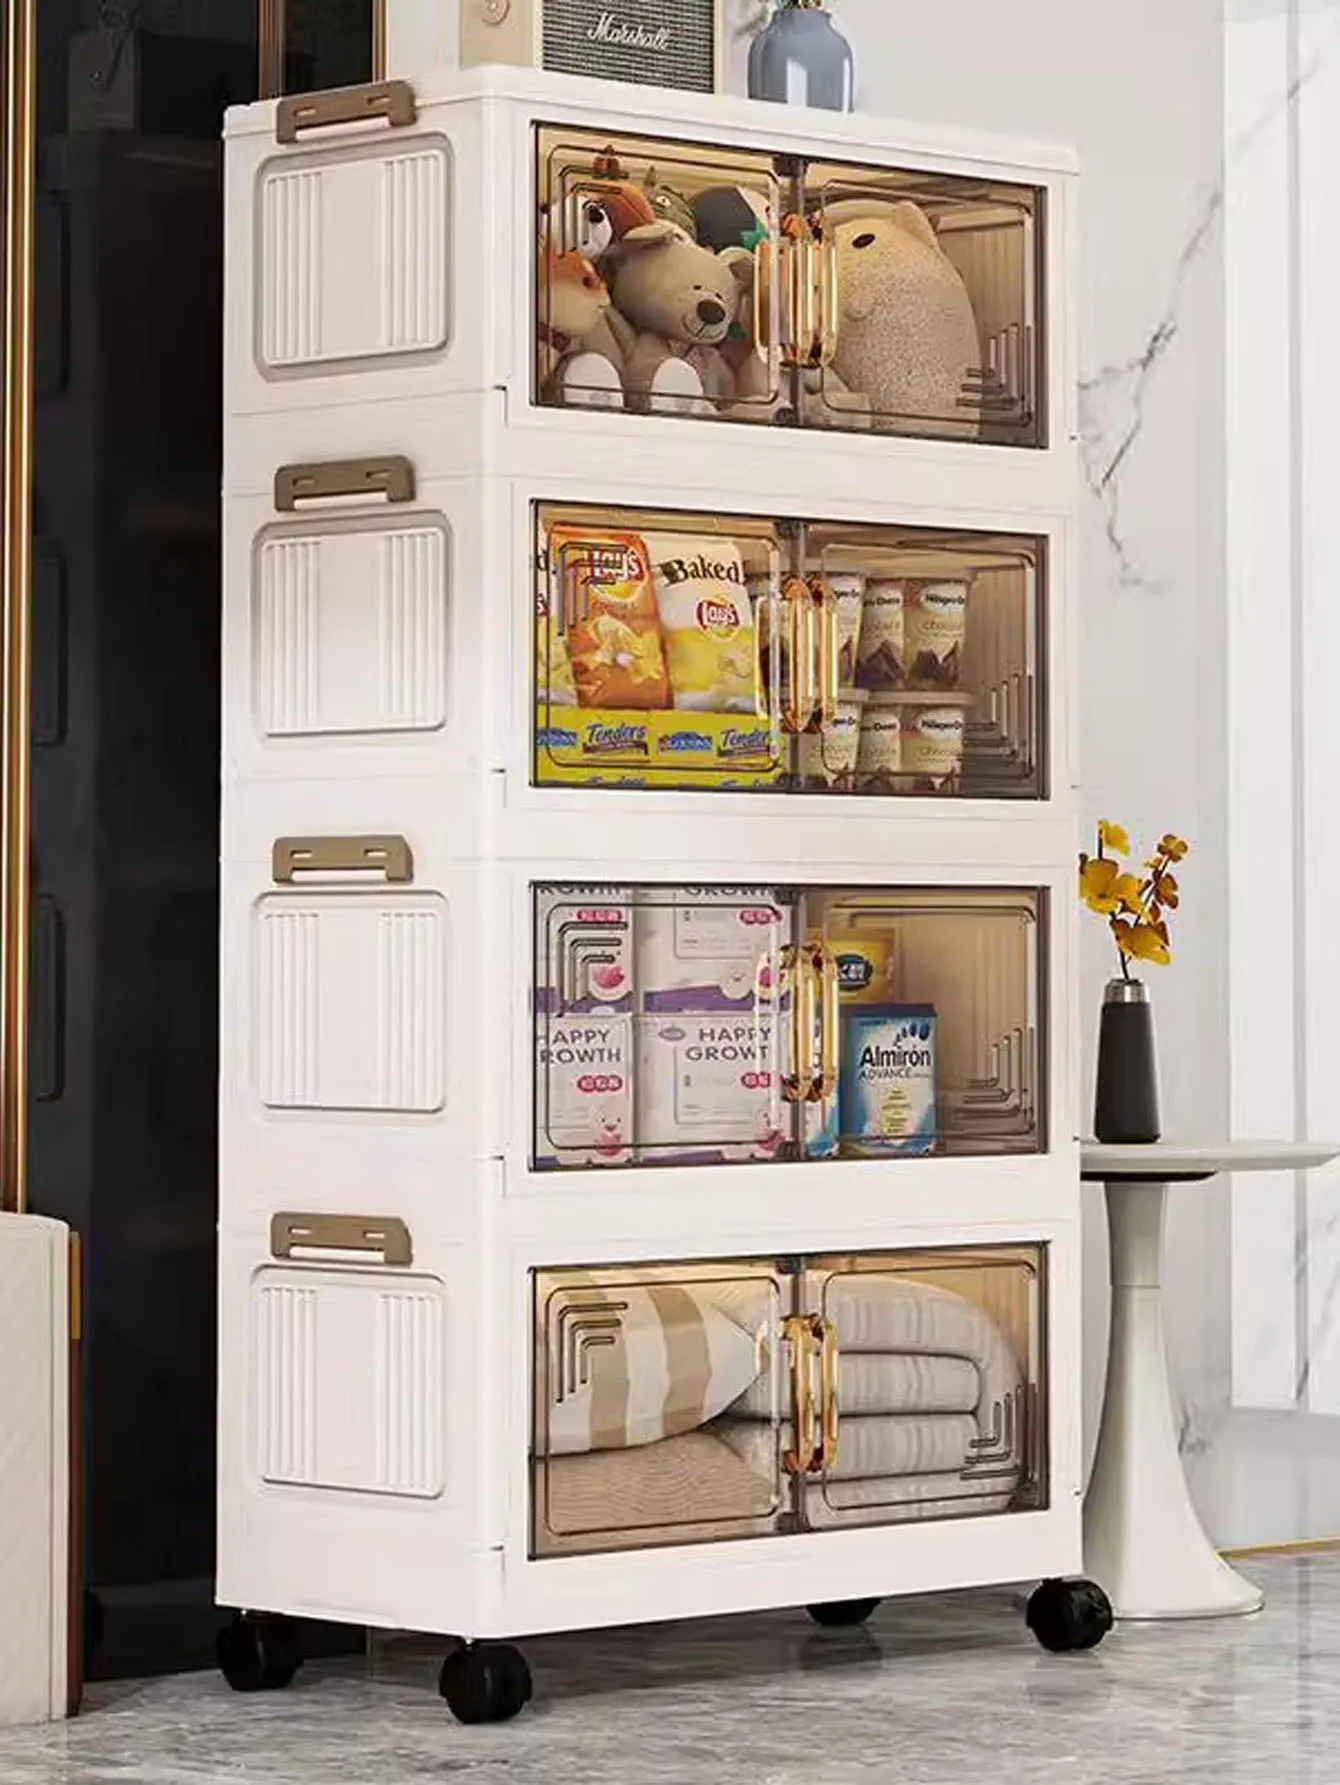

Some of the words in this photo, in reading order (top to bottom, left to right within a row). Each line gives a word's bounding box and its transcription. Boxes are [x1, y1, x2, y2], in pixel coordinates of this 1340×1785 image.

[587, 12, 669, 50] Marshall
[586, 722, 647, 744] Tenders
[699, 1027, 771, 1041] HAPPY
[541, 1048, 621, 1064] ROWTH
[686, 1046, 769, 1061] GROWT
[859, 1067, 913, 1082] ADVANCE
